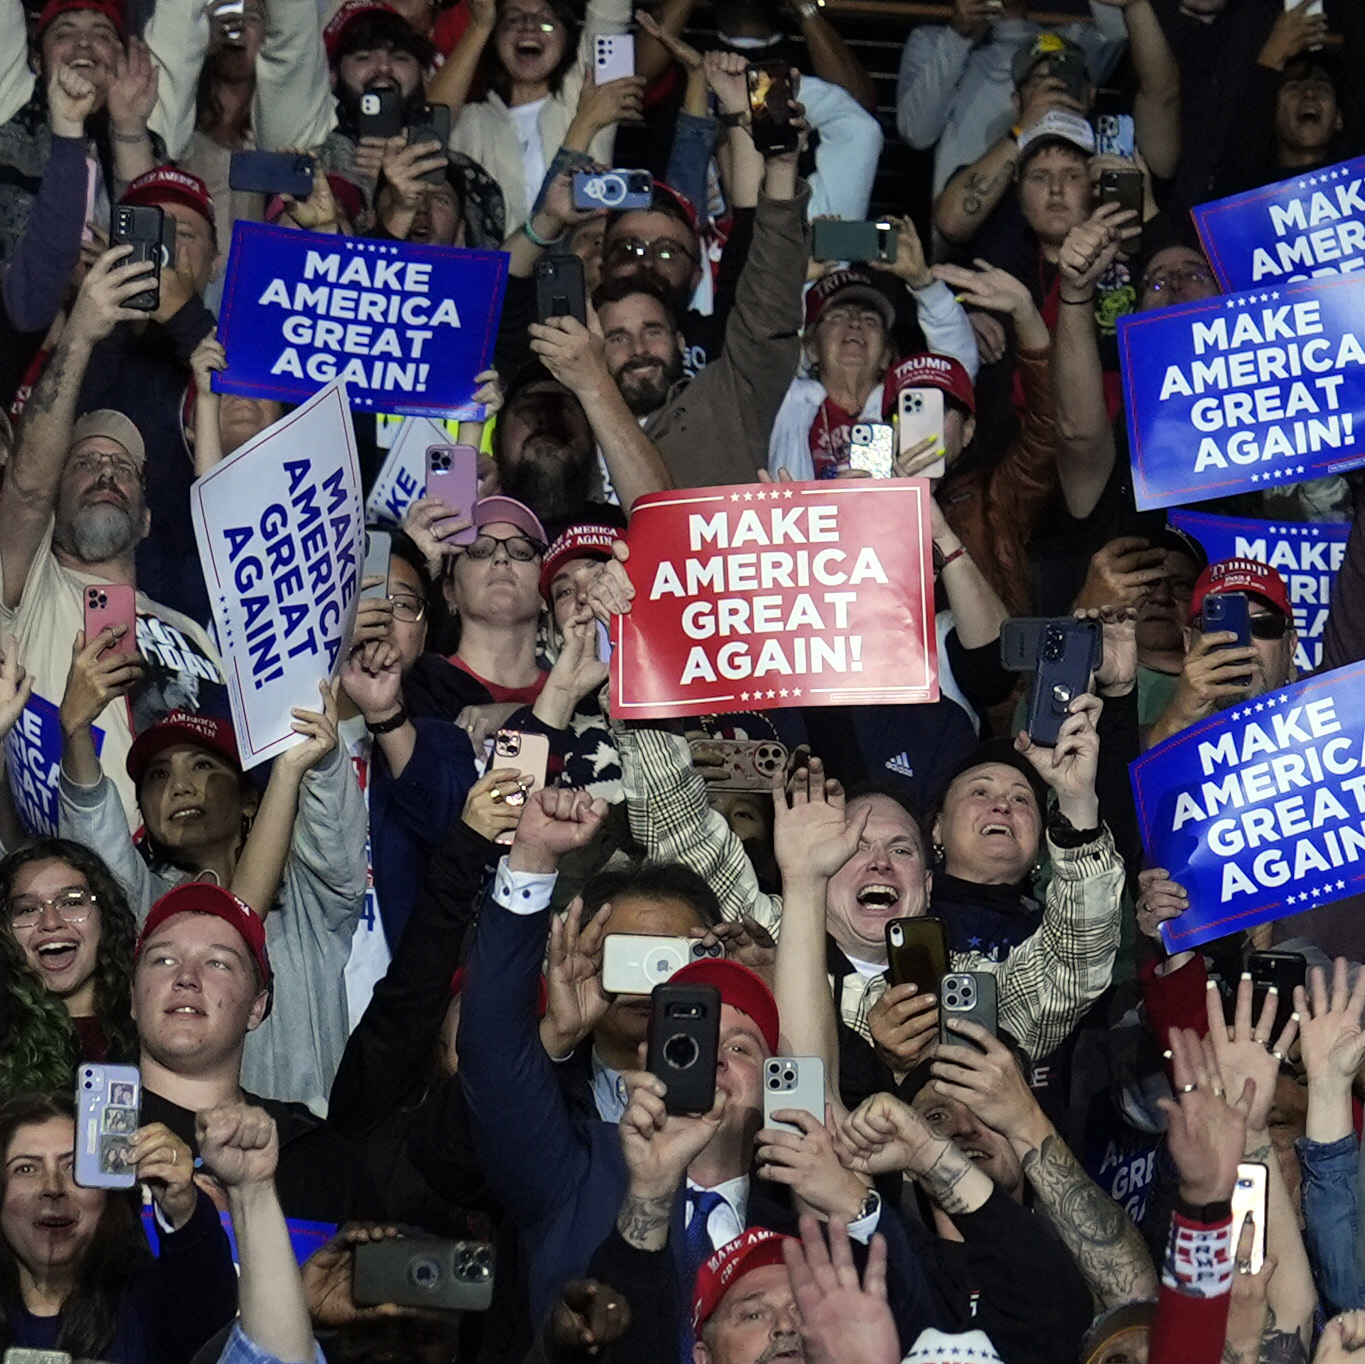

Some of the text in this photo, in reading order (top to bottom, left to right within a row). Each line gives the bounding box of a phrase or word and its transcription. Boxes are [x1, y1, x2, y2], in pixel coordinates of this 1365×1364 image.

[303, 249, 432, 292] MAKE
[259, 274, 461, 329] AMERICA
[1192, 300, 1323, 355] MAKE
[282, 315, 432, 357] GREAT
[271, 349, 431, 393] AGAIN!
[894, 357, 952, 377] TRUMP
[1190, 376, 1343, 433] GREAT
[1194, 413, 1353, 472] AGAIN!
[322, 466, 357, 611] MAKE
[566, 525, 618, 537] AMERICA
[577, 535, 612, 546] AGAIN
[689, 505, 838, 552] MAKE
[260, 503, 321, 658] GREAT
[283, 458, 344, 673] AMERICA
[651, 546, 888, 601] AMERICA
[224, 525, 283, 690] AGAIN!
[682, 592, 855, 642] GREAT
[681, 634, 862, 686] AGAIN!
[1200, 696, 1343, 775] MAKE
